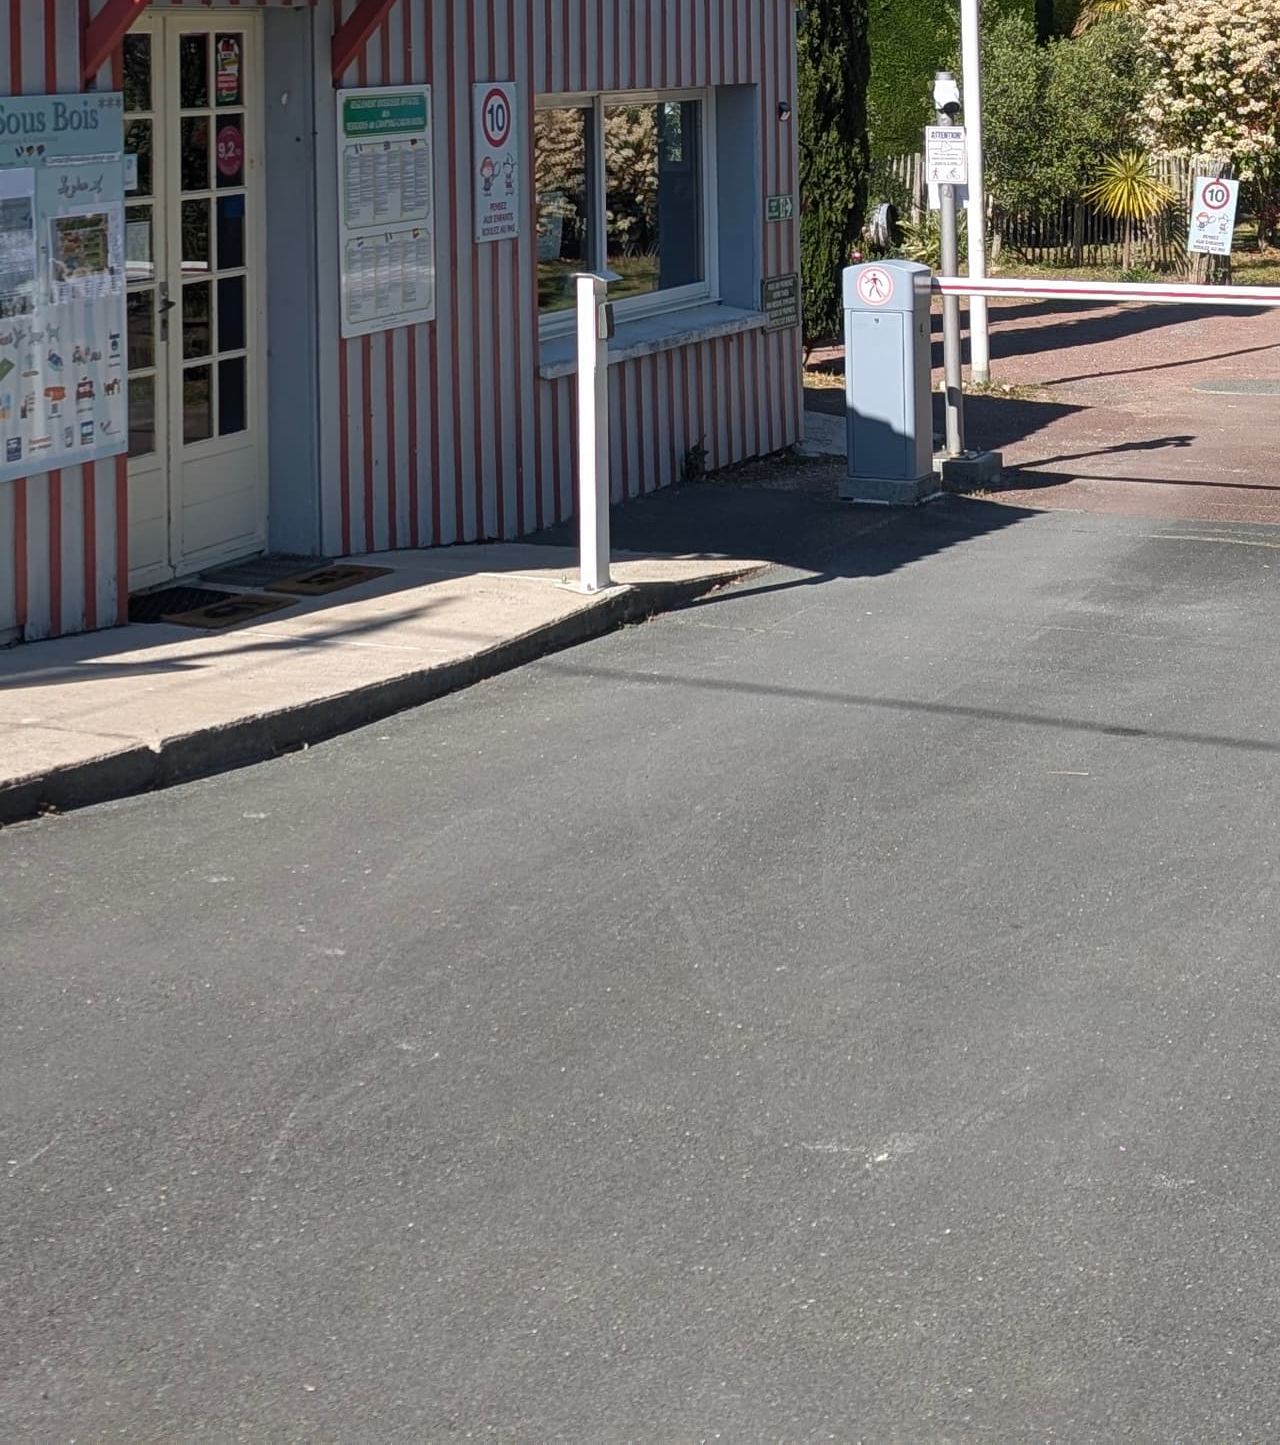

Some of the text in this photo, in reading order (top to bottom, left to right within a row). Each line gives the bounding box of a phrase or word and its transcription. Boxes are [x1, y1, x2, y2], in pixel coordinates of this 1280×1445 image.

[52, 100, 99, 131] Bois
[487, 103, 506, 132] 10
[1208, 188, 1225, 203] 10
